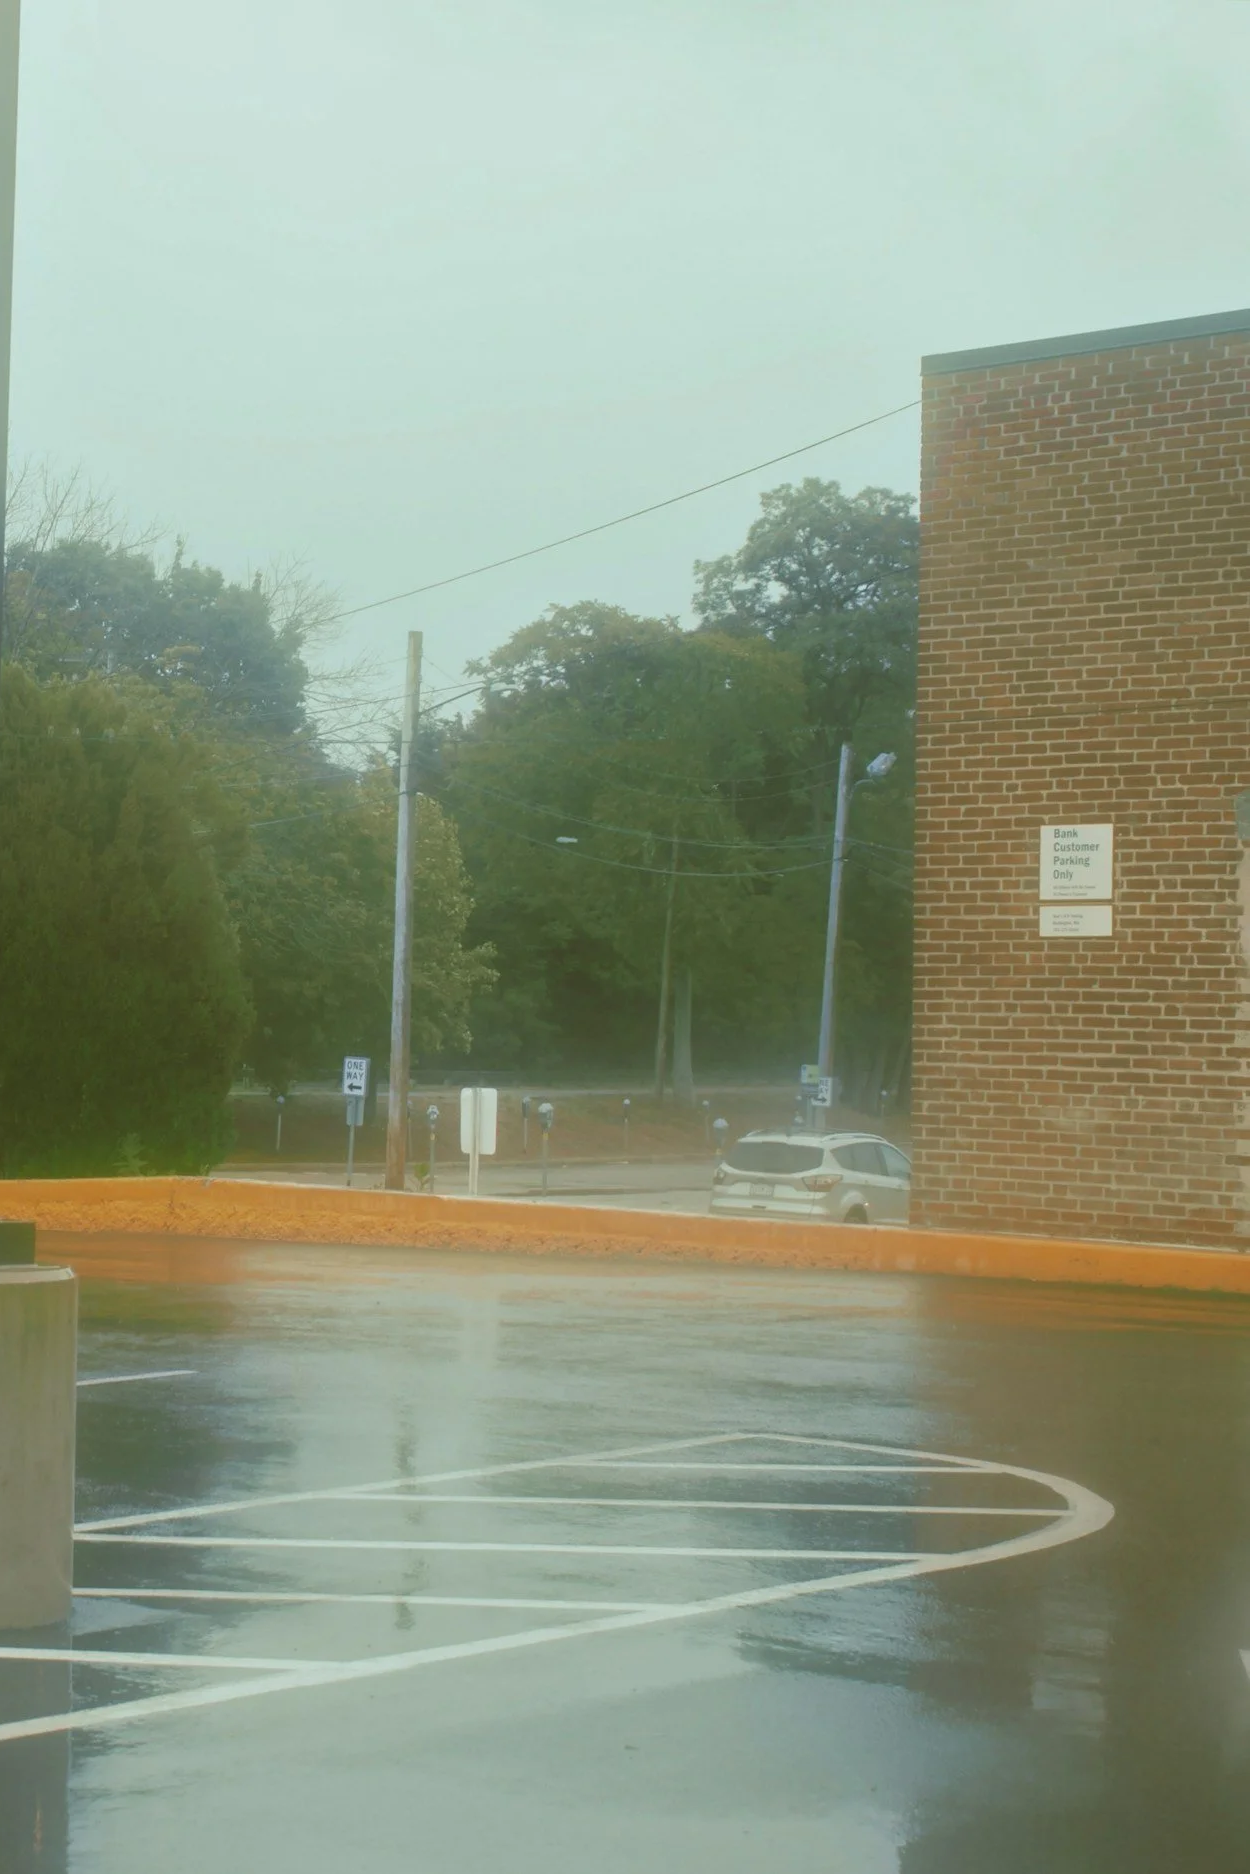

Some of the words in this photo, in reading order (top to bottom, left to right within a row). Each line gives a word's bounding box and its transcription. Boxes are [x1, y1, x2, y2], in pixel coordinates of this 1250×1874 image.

[1053, 828, 1078, 839] Bank
[1053, 842, 1100, 852] Customer
[1053, 855, 1090, 868] Parking
[1053, 869, 1073, 881] Only
[347, 1060, 364, 1071] ONE
[346, 1072, 364, 1080] WAY
